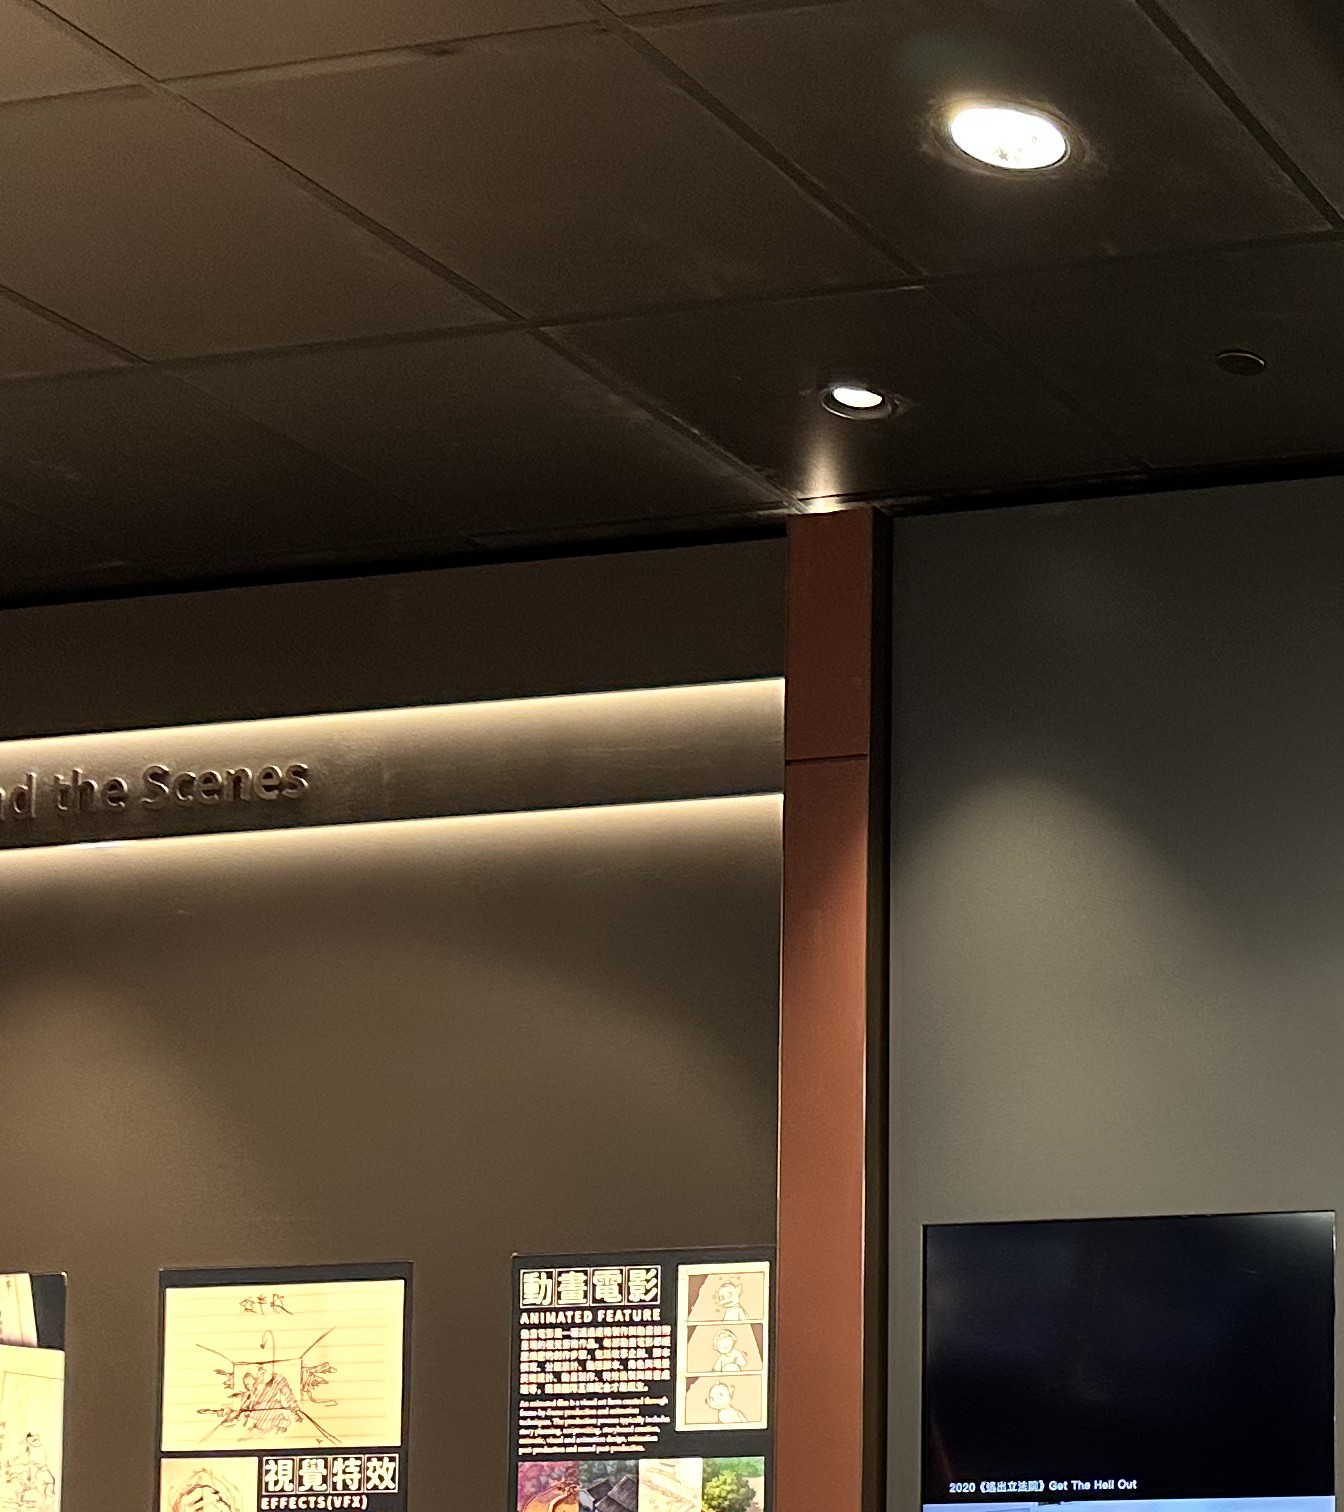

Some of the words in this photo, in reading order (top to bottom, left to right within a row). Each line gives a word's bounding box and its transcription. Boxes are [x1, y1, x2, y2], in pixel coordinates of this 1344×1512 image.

[54, 767, 126, 813] the
[142, 763, 309, 808] Scenes
[522, 1267, 658, 1307] 動畫電影
[519, 1310, 592, 1325] ANIMATED
[597, 1308, 661, 1322] FEATURE
[264, 1456, 396, 1492] 視覺特效
[949, 1482, 976, 1493] 2020
[1049, 1480, 1068, 1491] Get
[1071, 1480, 1091, 1490] The
[1094, 1479, 1114, 1490] Hell
[1118, 1479, 1137, 1489] Out
[260, 1495, 368, 1511] EFFECTS(VFX)
